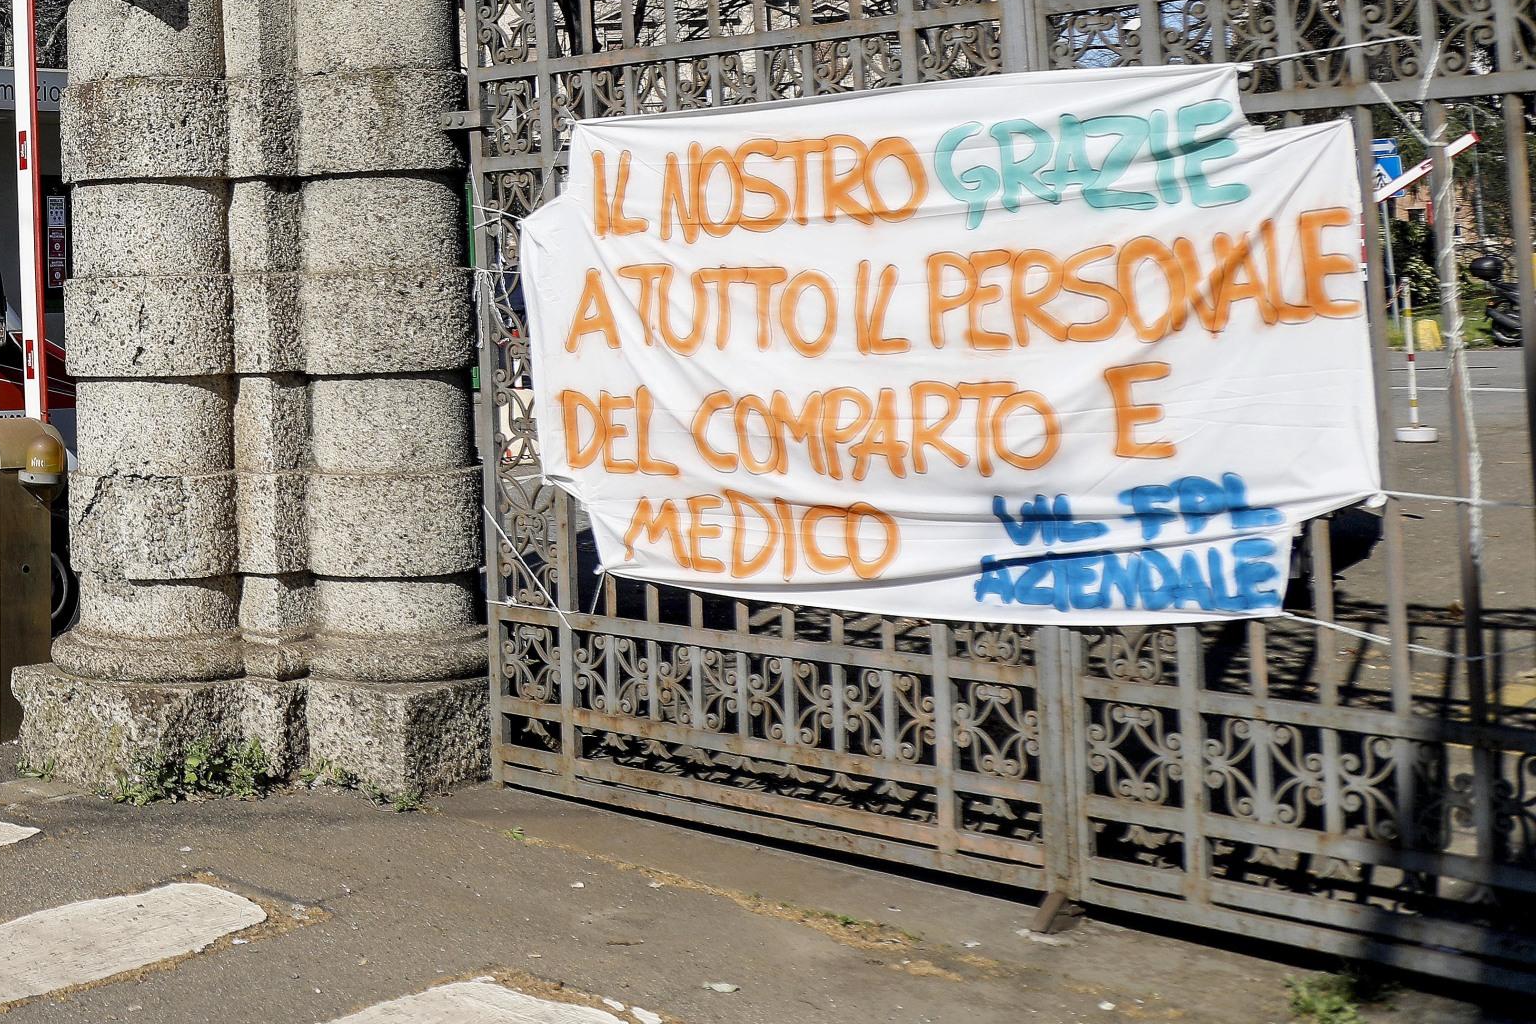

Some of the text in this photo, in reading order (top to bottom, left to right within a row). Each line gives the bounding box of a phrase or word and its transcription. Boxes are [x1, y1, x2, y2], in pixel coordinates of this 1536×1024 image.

[592, 98, 1251, 244] IL NOSTRO GRAZIE
[564, 206, 1363, 358] A TUTTO IL PERSONALE
[562, 361, 1177, 480] DEL COMPARTO E
[624, 489, 902, 583] MEDICO
[1118, 471, 1287, 541] FPL
[973, 536, 1283, 613] AZIENDALE
